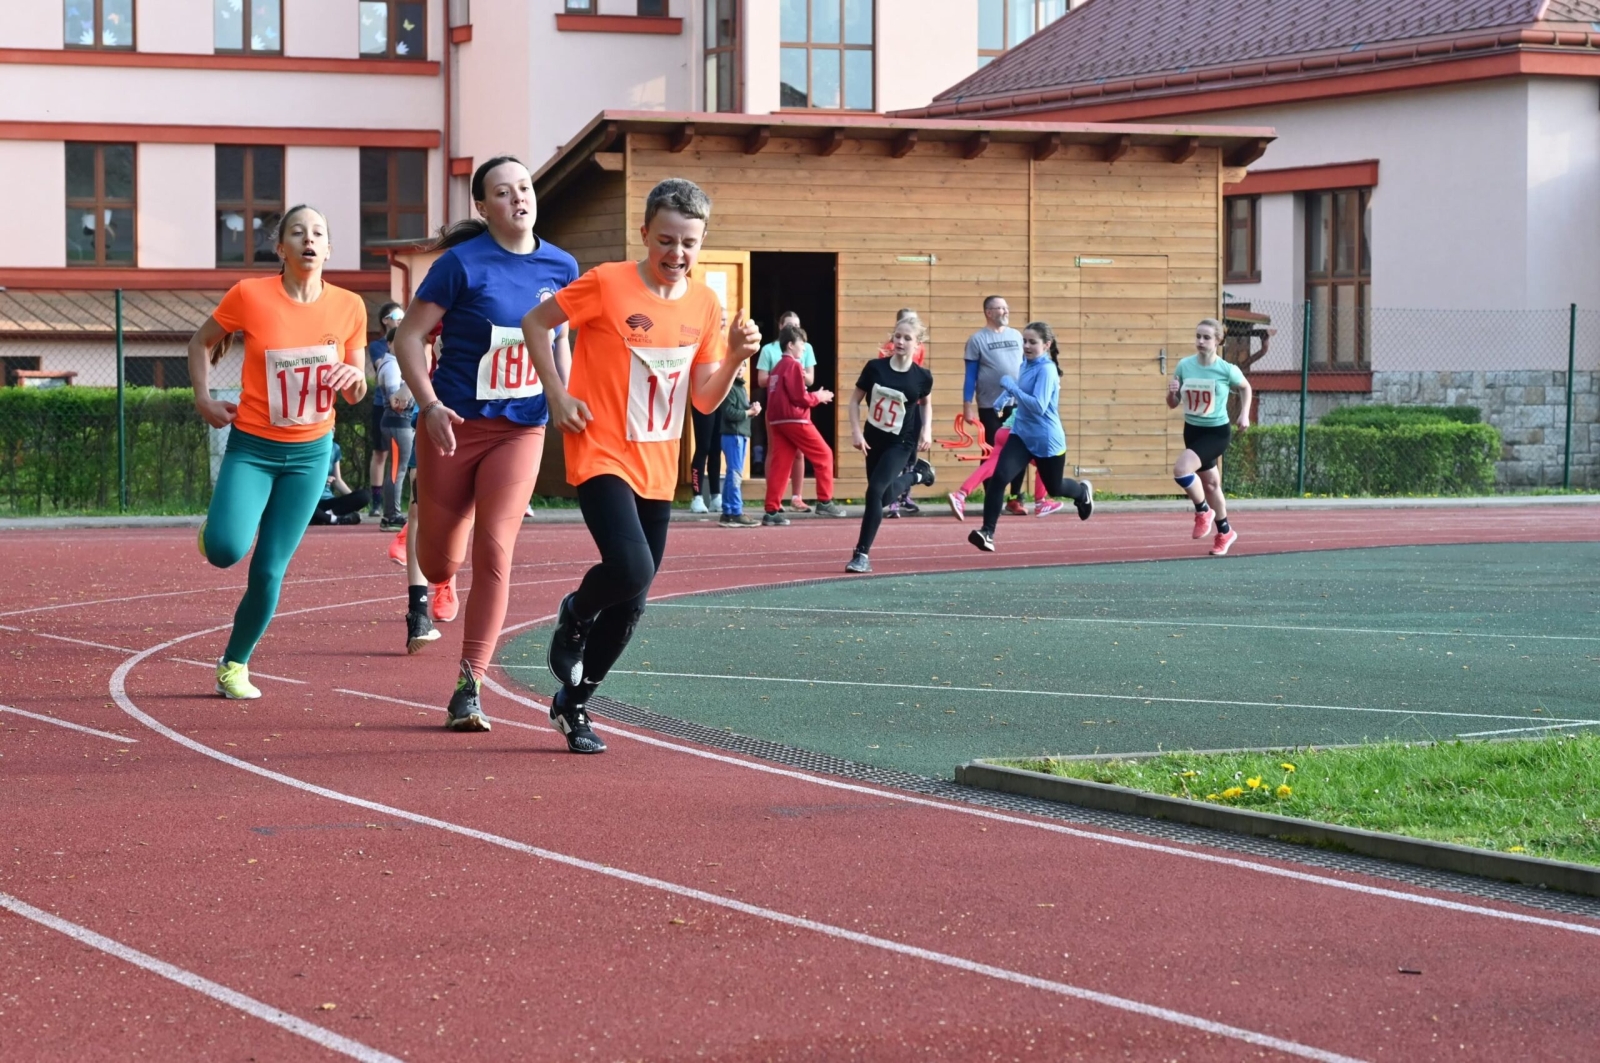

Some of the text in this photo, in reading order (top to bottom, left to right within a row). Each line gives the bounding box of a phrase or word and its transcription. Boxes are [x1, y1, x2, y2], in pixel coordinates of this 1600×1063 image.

[275, 355, 327, 369] PIVOVAR TRUTNOV
[647, 370, 681, 432] 17
[873, 397, 900, 428] 65
[1186, 390, 1211, 414] 179
